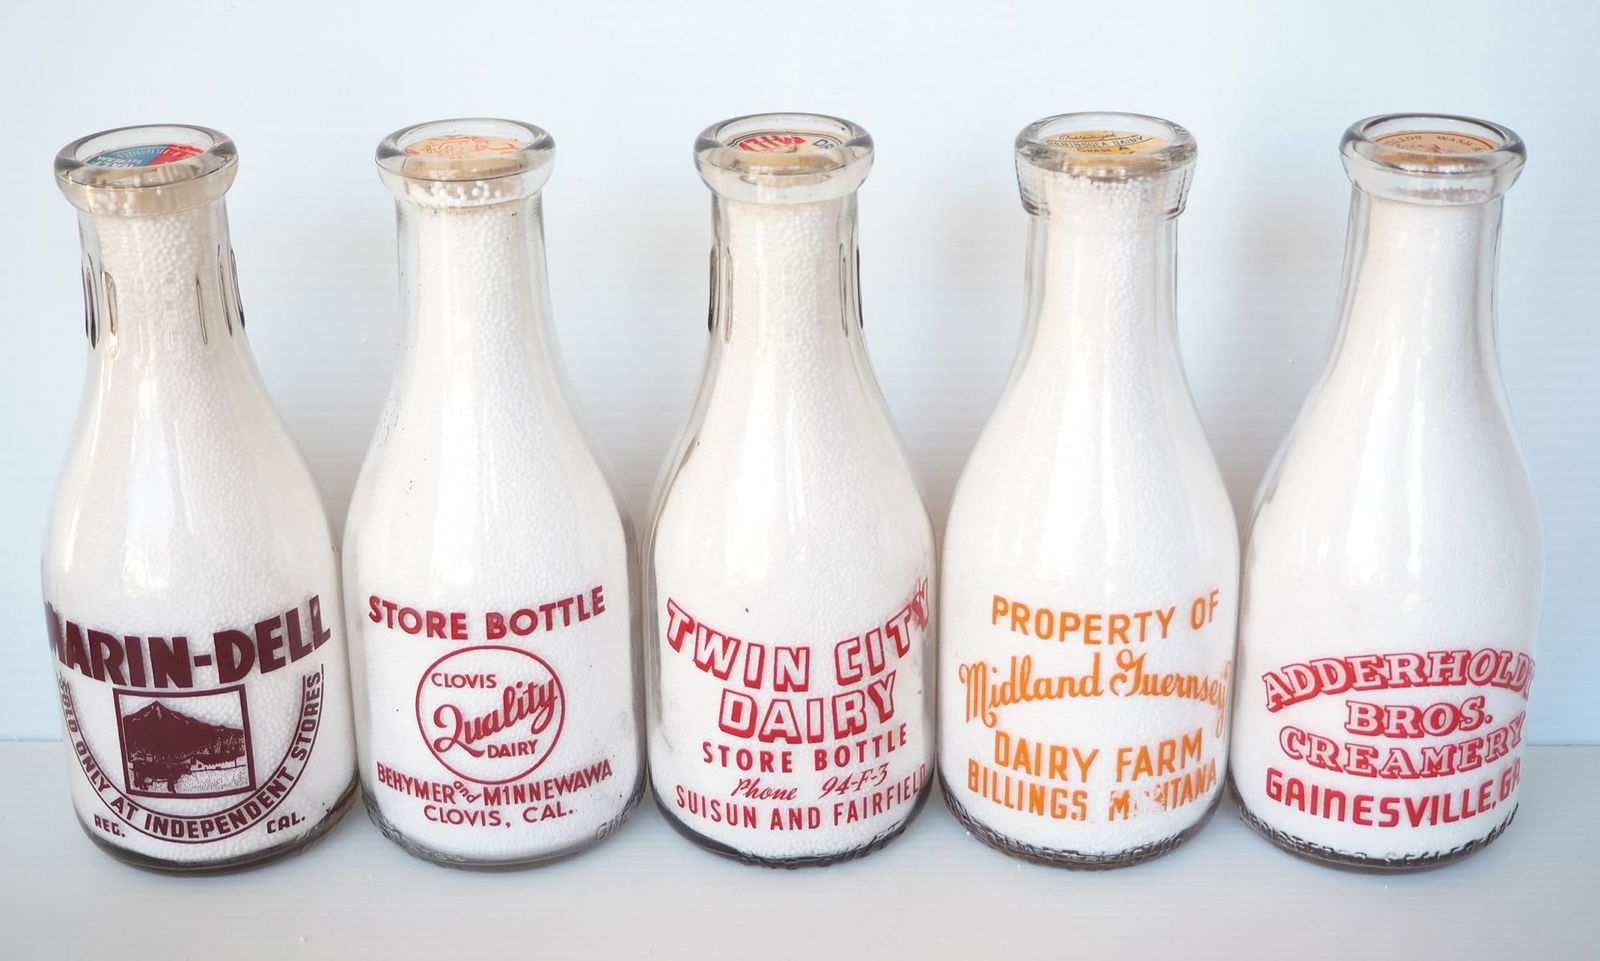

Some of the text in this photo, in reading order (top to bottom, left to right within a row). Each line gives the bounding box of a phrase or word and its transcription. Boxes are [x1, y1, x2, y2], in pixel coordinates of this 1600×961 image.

[368, 585, 606, 640] STORE BOTTLE
[666, 577, 929, 692] TWIN CITY
[991, 589, 1220, 645] PROPERTY OF
[431, 672, 497, 688] CLOVIS
[718, 670, 896, 744] DAIRY
[958, 652, 1104, 728] Midland
[433, 678, 558, 758] Quality
[1279, 711, 1526, 779] CREAMERY
[1345, 696, 1494, 738] BROS.
[75, 740, 110, 791] ONLY
[111, 796, 139, 820] AT
[144, 766, 294, 839] INDEPENDENT
[291, 671, 321, 760] STORES
[487, 739, 538, 758] DAIRY
[702, 723, 907, 773] STORE BOTTLE
[994, 727, 1202, 783] DAIRY FARM
[377, 761, 457, 805] BEHYMER
[453, 780, 481, 803] and
[675, 784, 757, 829] SUISUN
[770, 808, 821, 831] AND
[833, 765, 926, 826] FAIRFIELD
[730, 763, 890, 801] Phone 94-F-3
[967, 758, 1088, 821] BILLINGS
[94, 813, 306, 838] REG. CAL.
[424, 803, 573, 828] CLOVIS, CAL.
